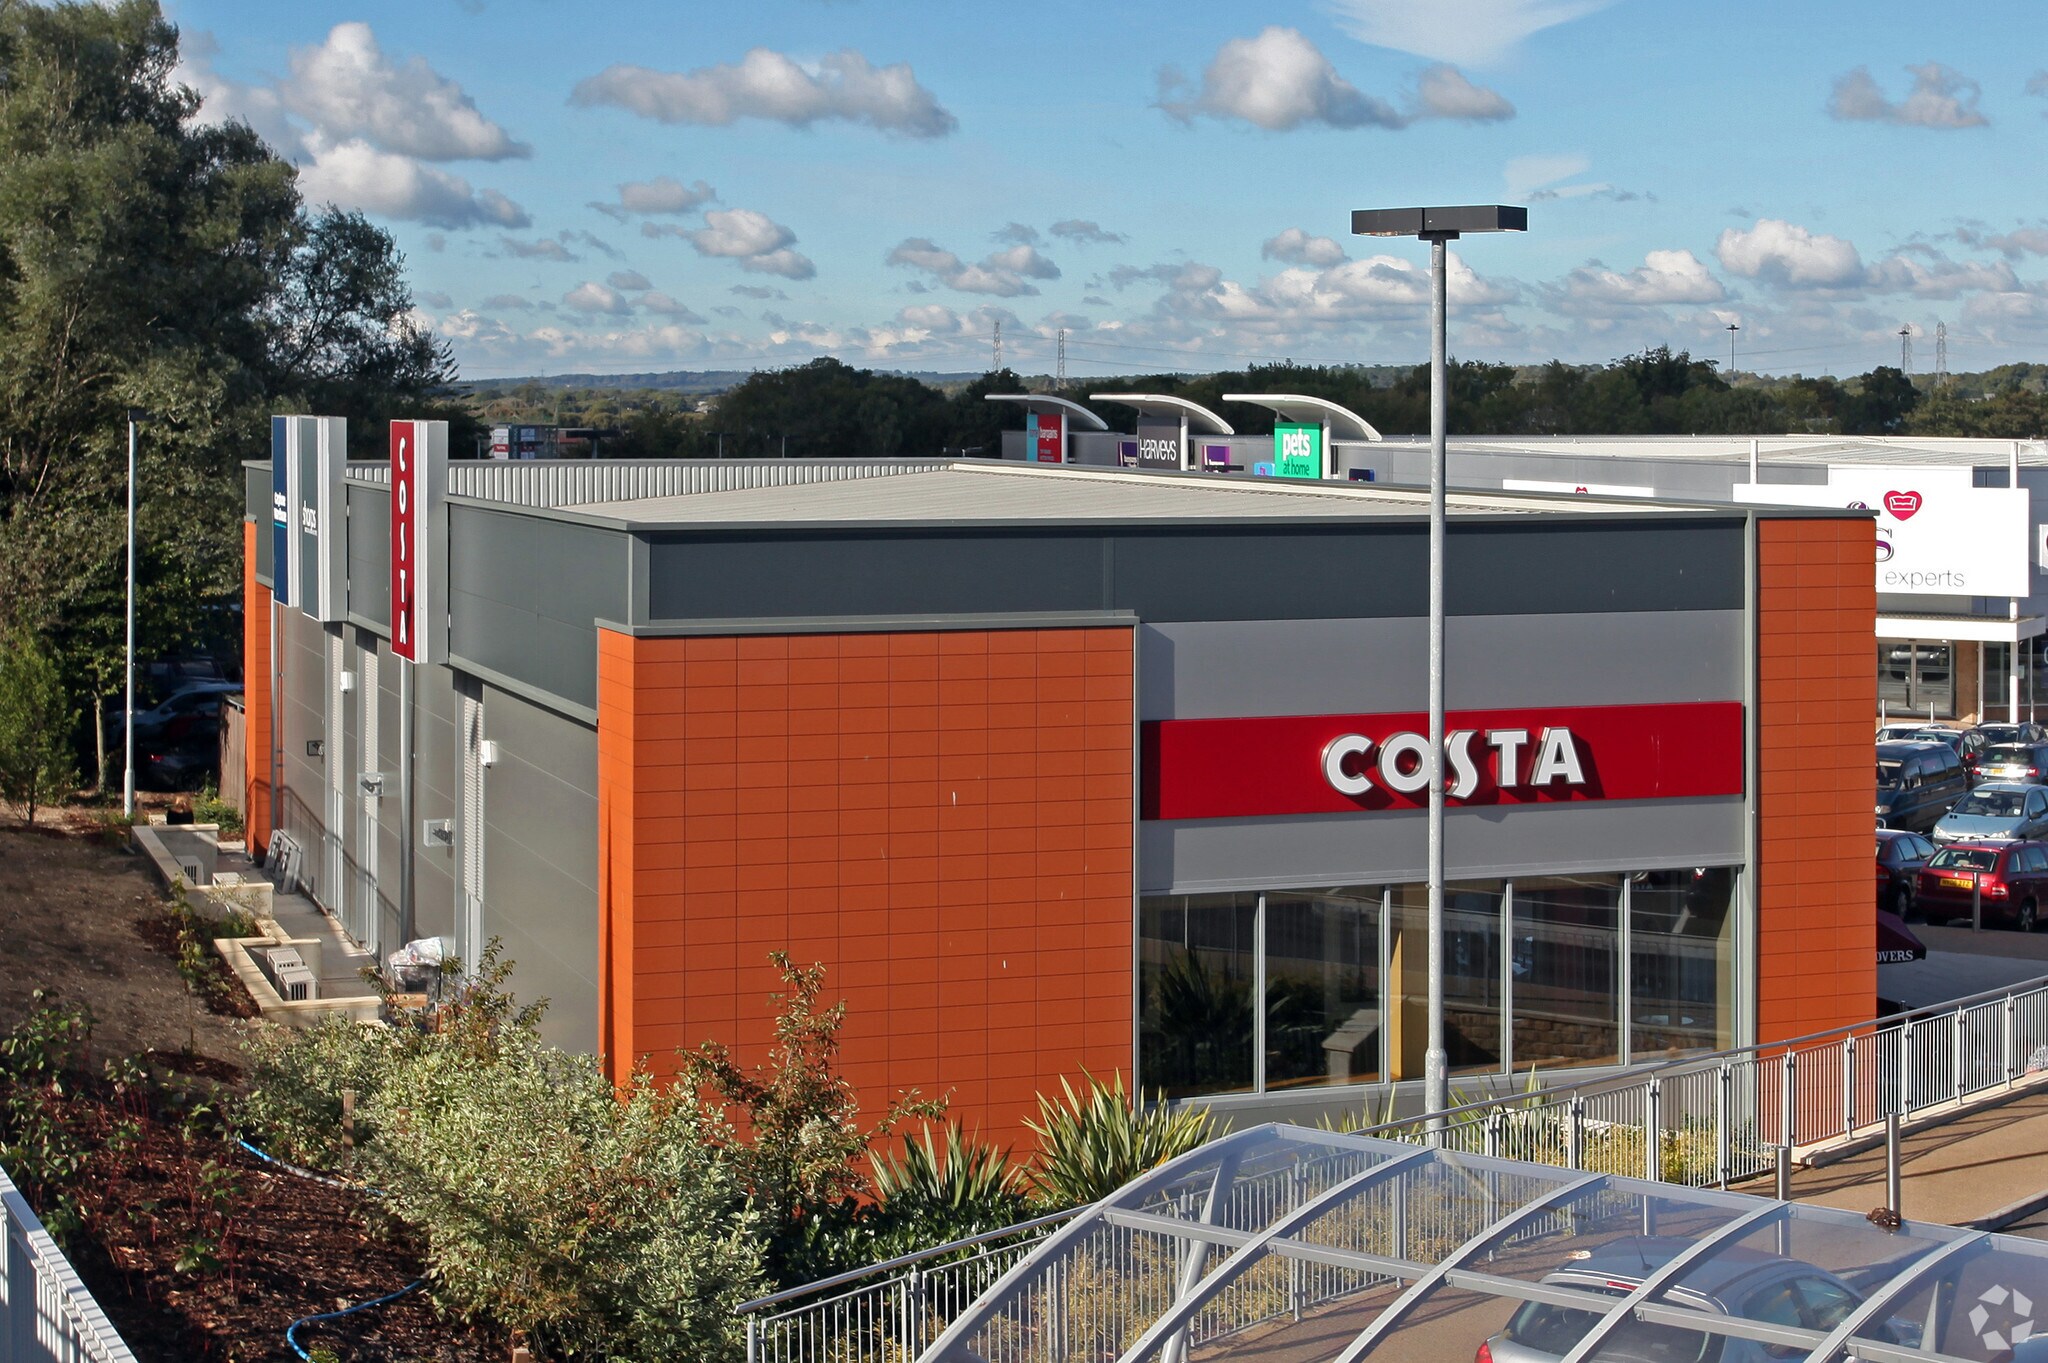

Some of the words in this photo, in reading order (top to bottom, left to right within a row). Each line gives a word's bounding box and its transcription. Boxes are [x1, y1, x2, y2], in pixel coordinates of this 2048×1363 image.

[1282, 428, 1311, 461] pets
[1283, 462, 1290, 474] at
[1291, 459, 1310, 476] home
[1885, 568, 1966, 589] experts
[1321, 726, 1586, 799] COSTA
